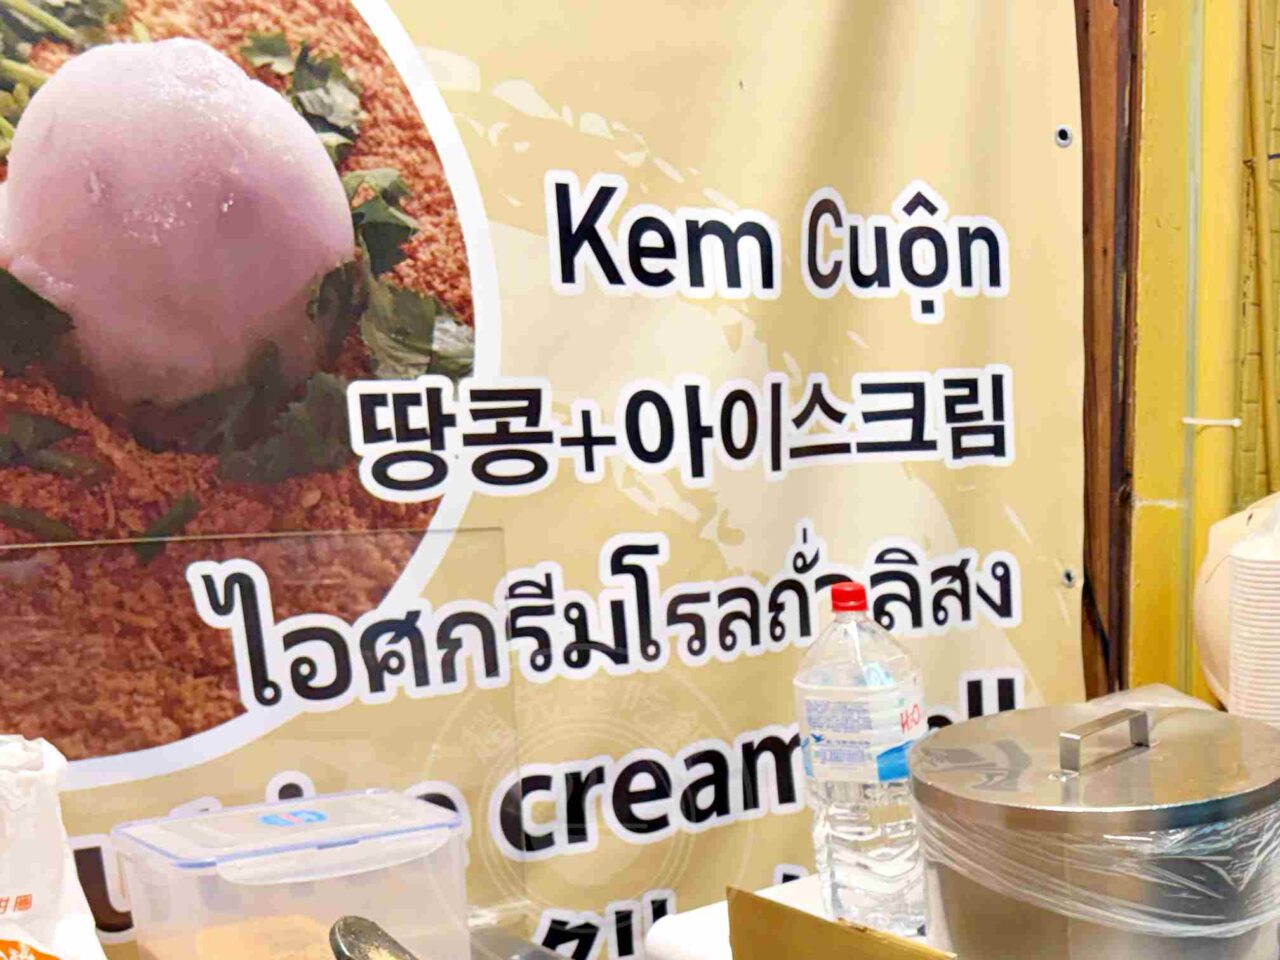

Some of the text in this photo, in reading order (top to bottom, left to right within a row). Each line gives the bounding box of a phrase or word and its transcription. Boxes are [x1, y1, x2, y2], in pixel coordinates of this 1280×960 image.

[553, 182, 1001, 313] Kem Cuộn
[359, 374, 1005, 491] 땅콩+아이스크림
